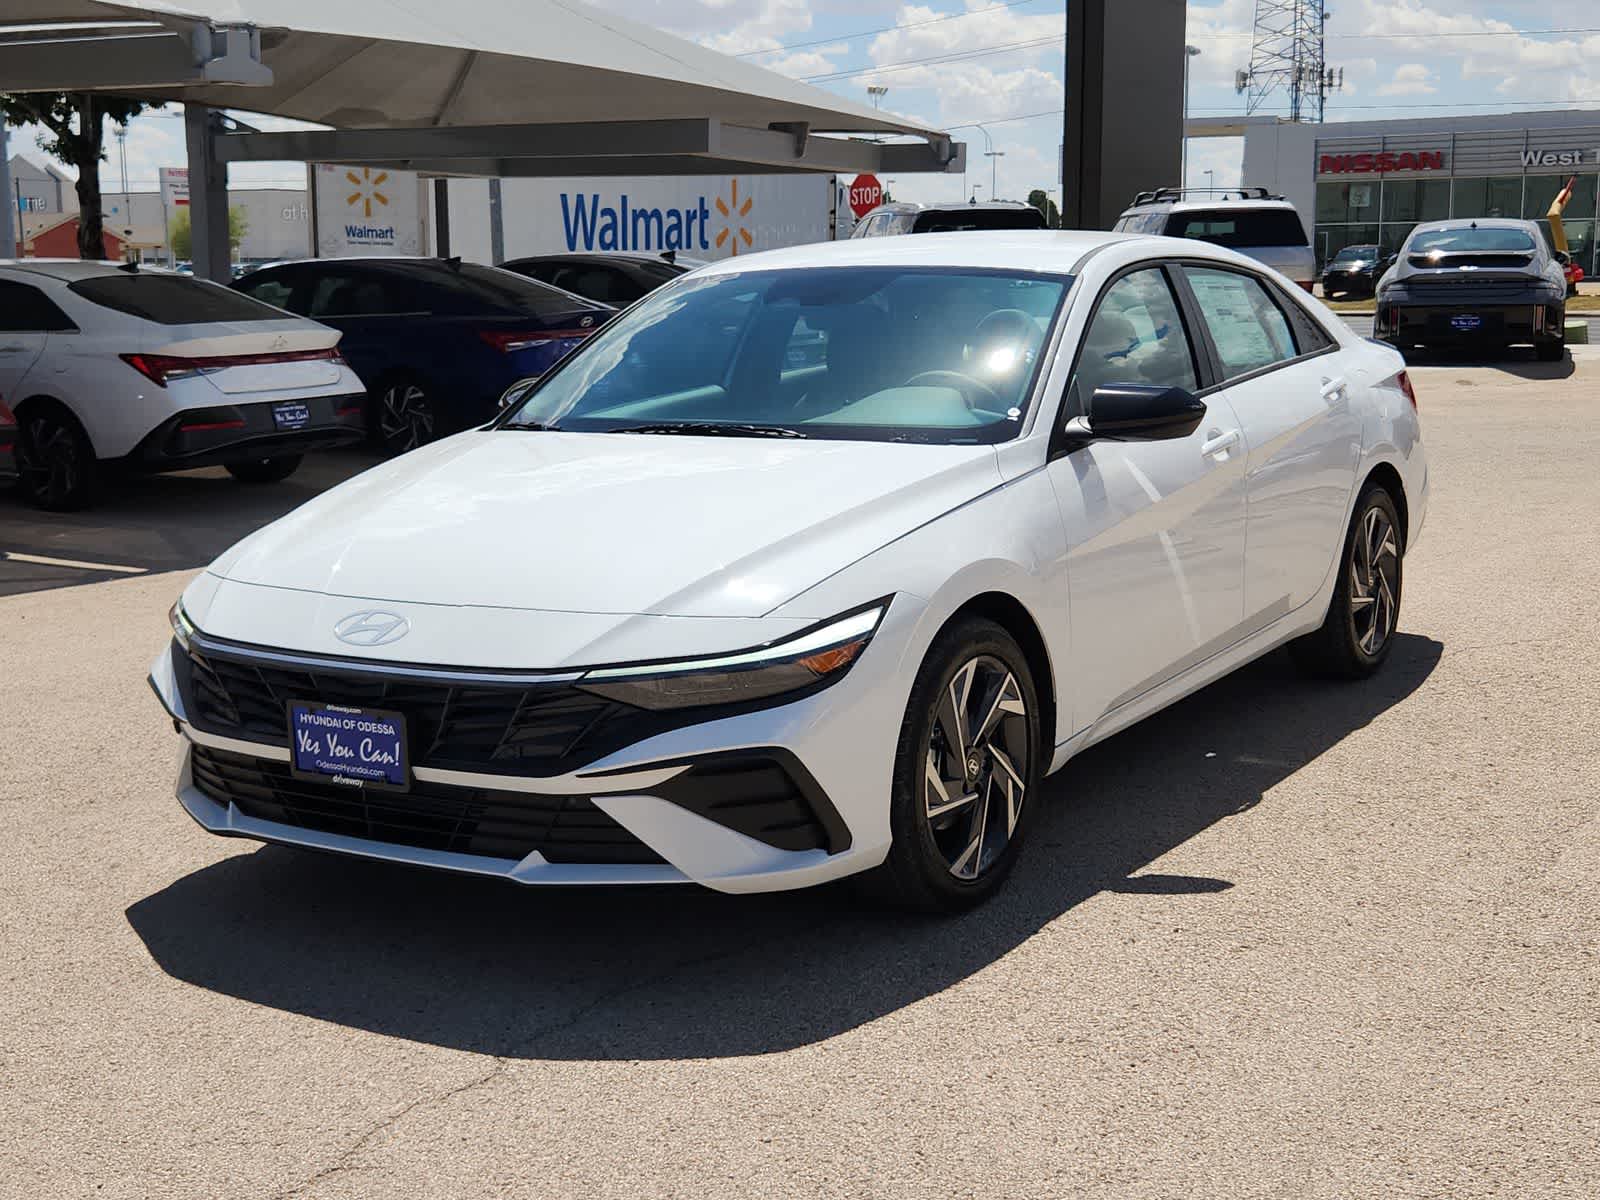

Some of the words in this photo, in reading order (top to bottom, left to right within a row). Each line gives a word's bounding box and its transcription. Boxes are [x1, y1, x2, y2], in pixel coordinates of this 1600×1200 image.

[1319, 150, 1443, 174] NISSAN
[1519, 149, 1582, 167] West
[851, 186, 880, 206] STOP
[344, 224, 394, 240] Walmart
[560, 194, 709, 252] Walmart
[300, 713, 342, 729] HYUNDAI
[342, 719, 357, 730] OF
[357, 721, 395, 735] ODESSA
[297, 729, 321, 754] Yes
[326, 733, 355, 757] You
[359, 737, 400, 766] Can!
[315, 760, 385, 776] OdessaHyundai.com
